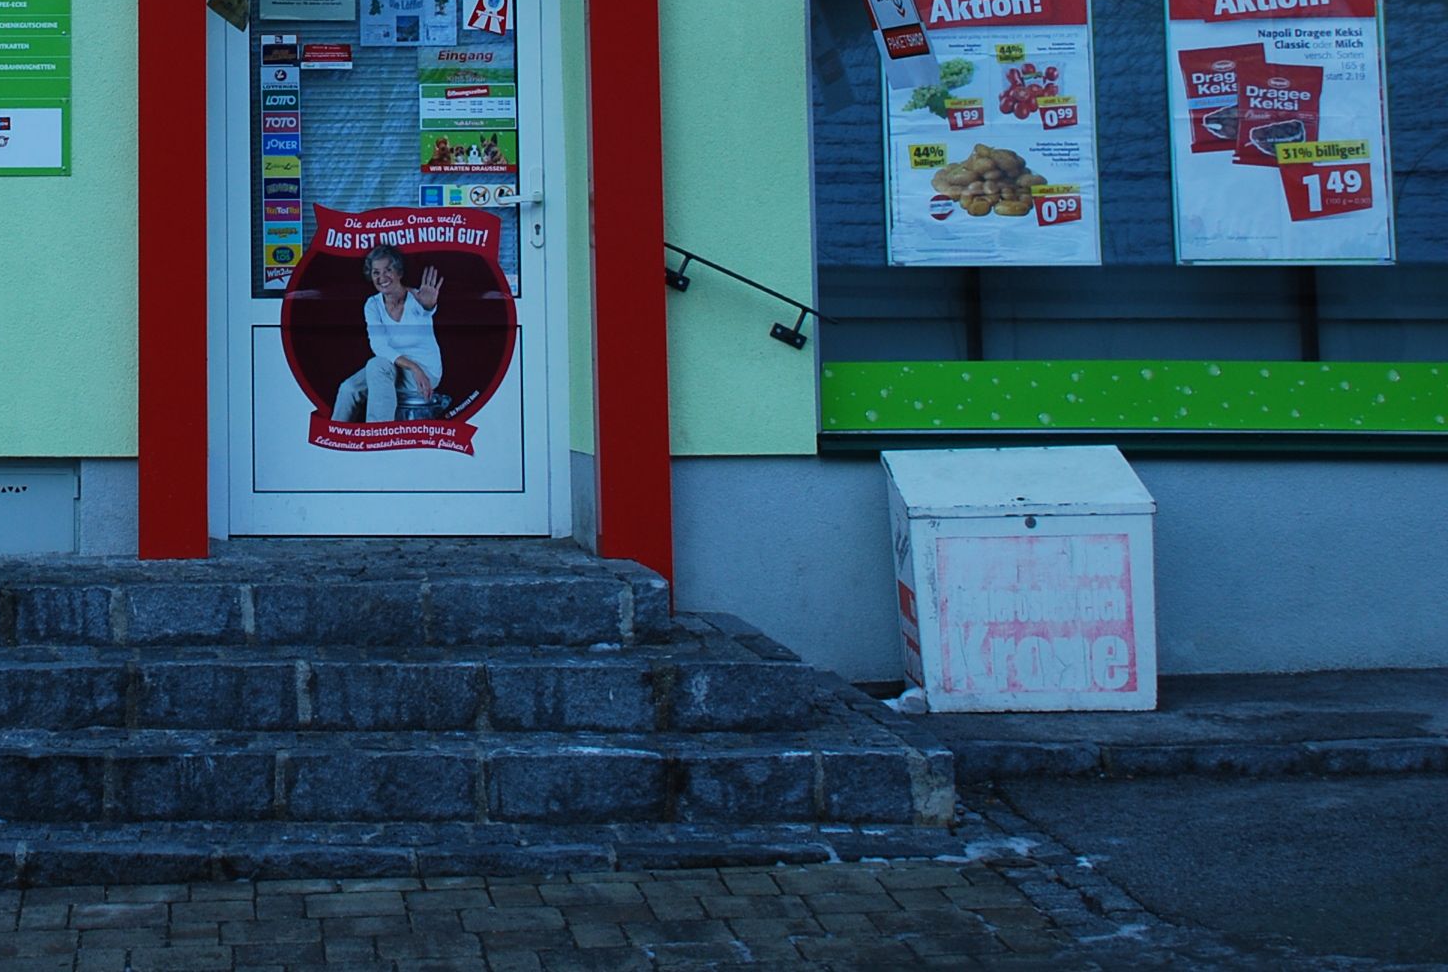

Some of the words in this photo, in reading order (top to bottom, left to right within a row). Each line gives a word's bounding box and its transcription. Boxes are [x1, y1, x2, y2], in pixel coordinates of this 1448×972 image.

[1257, 29, 1291, 39] Napoli
[1294, 28, 1331, 39] Dragee
[1334, 27, 1362, 37] Keksi
[1274, 40, 1310, 49] Classic
[1312, 40, 1331, 48] oder
[1335, 39, 1363, 48] Milch
[438, 50, 493, 62] Eingang
[1336, 51, 1363, 59] Sorten
[1325, 72, 1342, 80] statt
[1344, 72, 1365, 80] 2.19
[1245, 85, 1311, 101] Dragee
[265, 95, 296, 106] LOTTO
[1249, 98, 1298, 110] Keksi
[265, 116, 297, 128] TOTO
[265, 139, 298, 150] JOKER
[913, 146, 944, 158] 44%
[1283, 148, 1312, 160] 31%
[1315, 143, 1365, 159] billiger!
[914, 159, 945, 168] billiger!
[344, 218, 363, 229] Die
[365, 218, 405, 229] schlaue
[407, 215, 434, 225] Oma
[437, 214, 467, 227] weiß:
[325, 229, 352, 249] DAS
[354, 233, 376, 250] IST
[379, 229, 415, 246] DOCH
[418, 227, 454, 243] NOCH
[457, 227, 489, 247] GUT!
[328, 425, 456, 437] www.dasistdochnochgut.at
[314, 436, 364, 449] Lebensmittel
[366, 438, 417, 449] wertschätzen
[438, 439, 469, 452] früher!
